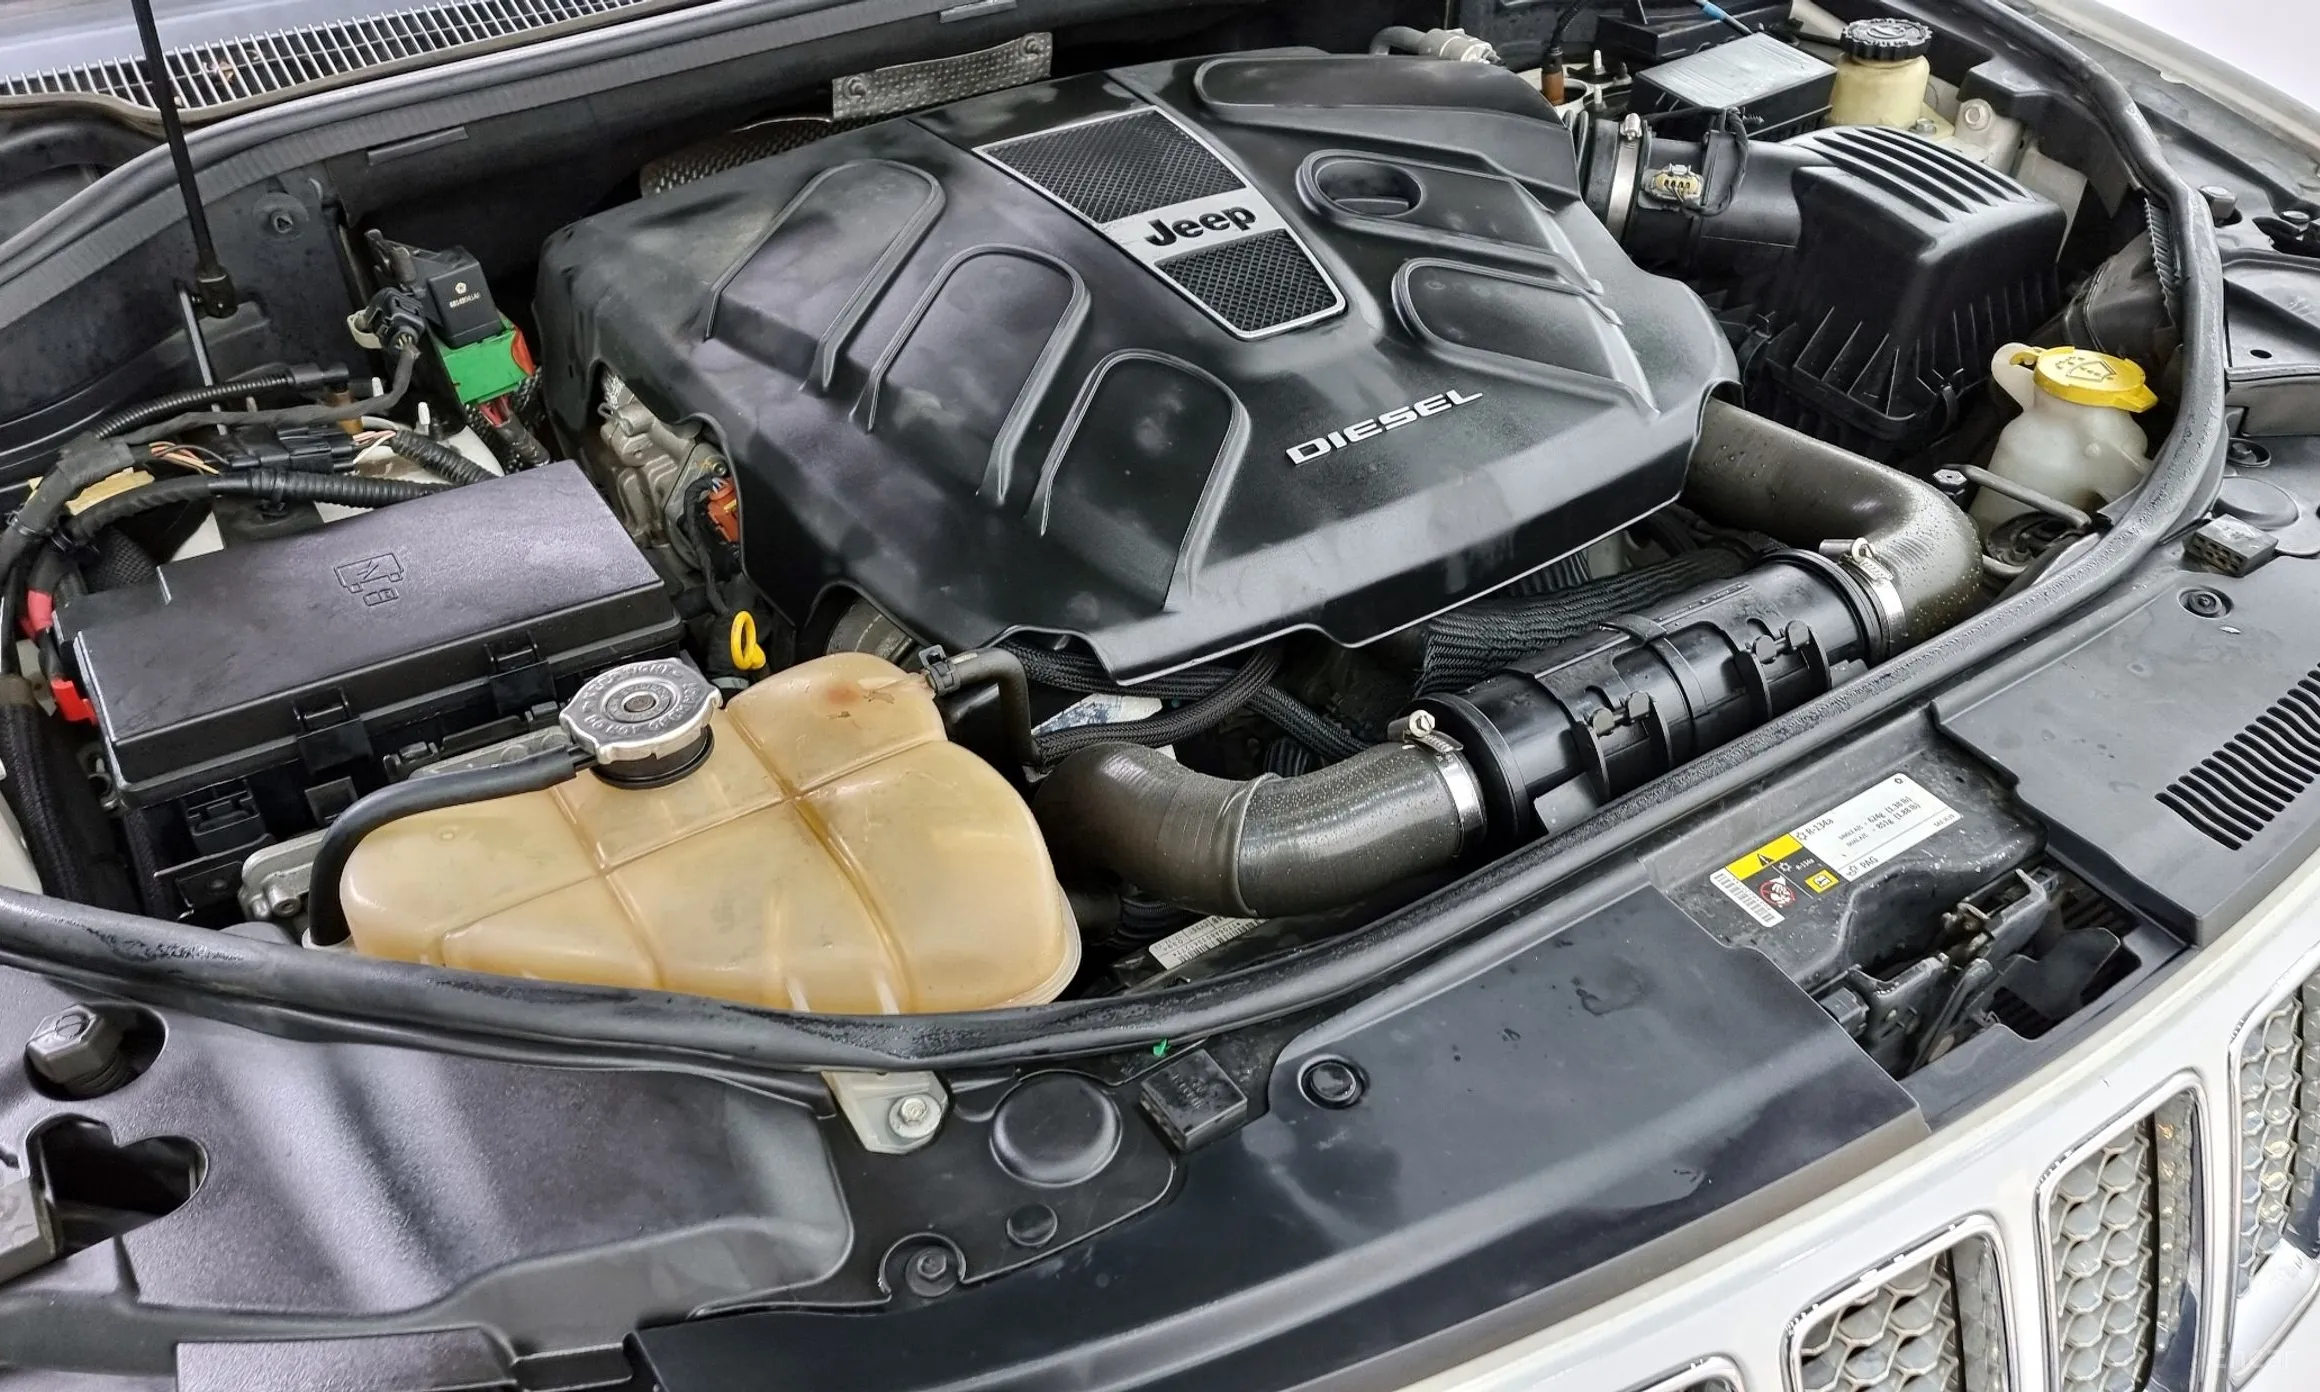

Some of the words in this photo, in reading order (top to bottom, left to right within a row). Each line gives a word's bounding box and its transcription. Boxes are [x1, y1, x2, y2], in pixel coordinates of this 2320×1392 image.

[1144, 207, 1256, 246] Jeep
[1285, 389, 1483, 465] DIESEL
[1805, 818, 1834, 835] R-134a
[1860, 856, 1879, 869] PAG
